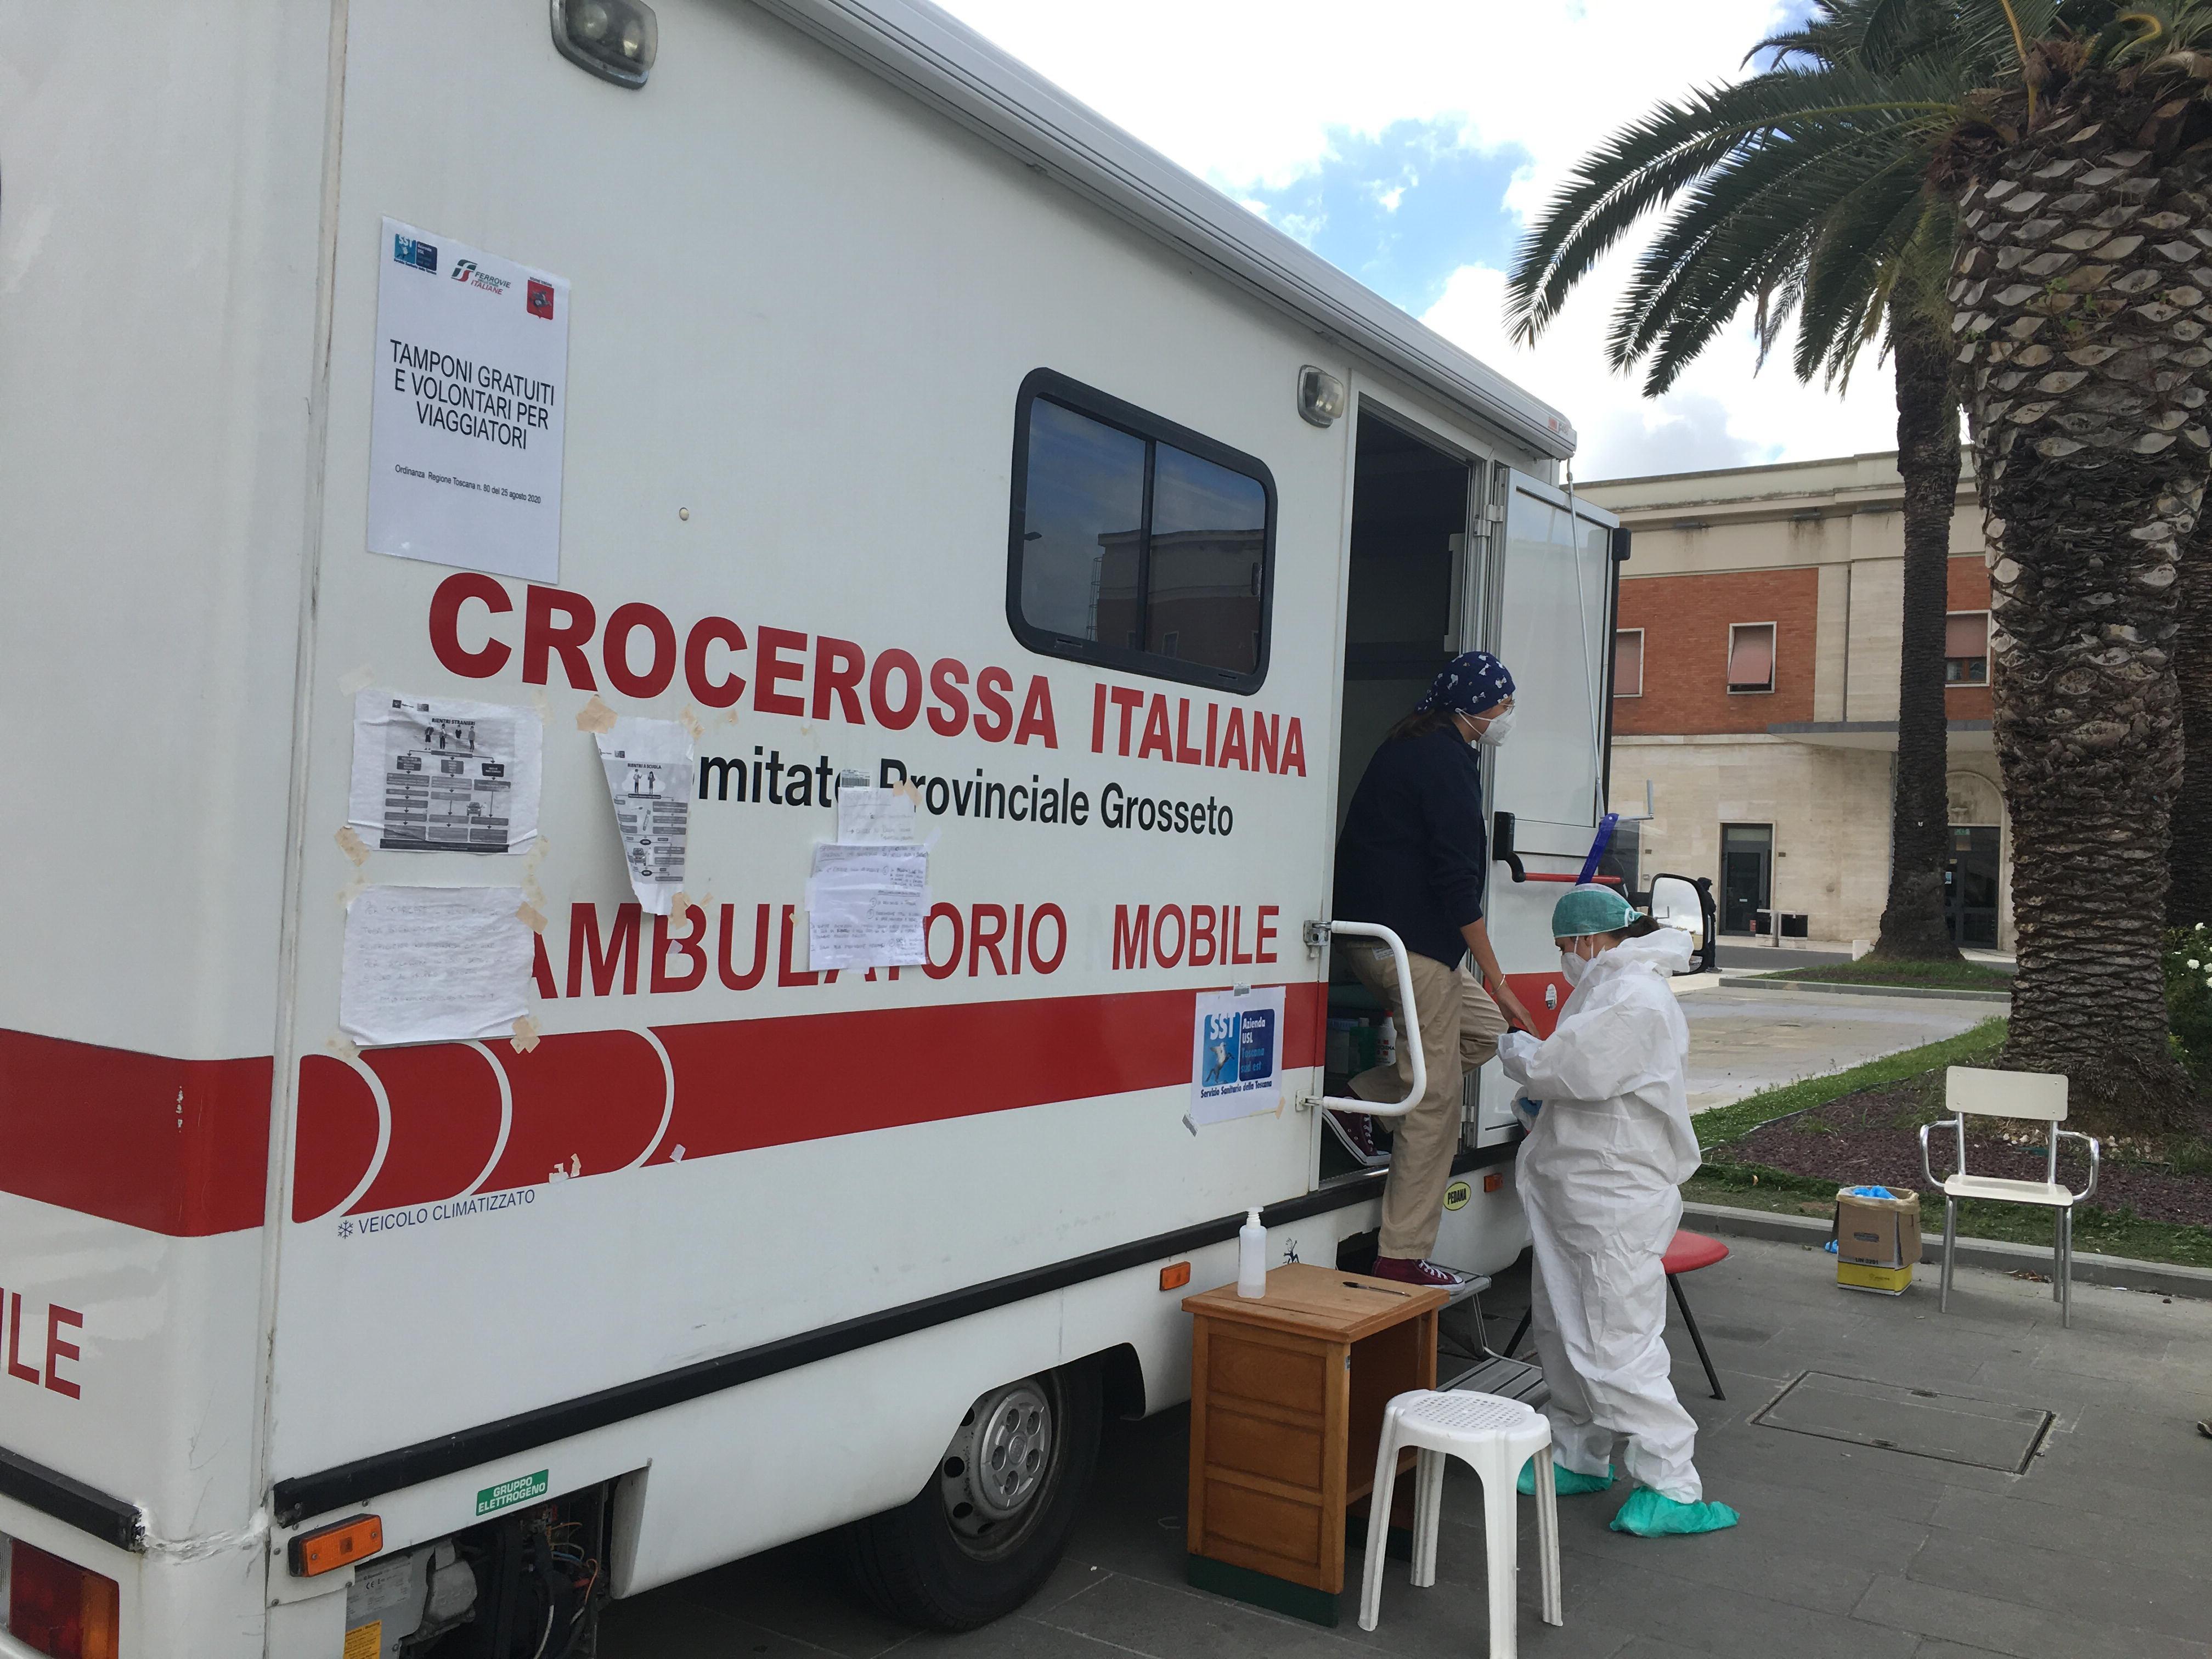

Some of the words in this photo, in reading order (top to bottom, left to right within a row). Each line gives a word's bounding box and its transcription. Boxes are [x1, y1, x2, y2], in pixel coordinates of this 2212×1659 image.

[470, 279, 504, 295] ITALIANE
[475, 271, 511, 289] FERROVIE
[390, 338, 472, 383] TAMPONI
[478, 365, 555, 406] GRATUITI
[394, 368, 405, 392] E
[411, 372, 511, 420] VOLONTARI
[517, 401, 549, 430] PER
[416, 400, 527, 450] VIAGGIATORI
[395, 464, 425, 479] Ordinanza
[428, 471, 452, 484] Regione
[453, 476, 476, 490] Toscana
[492, 486, 500, 495] del
[501, 488, 508, 497] 25
[509, 490, 527, 500] agosto
[528, 494, 541, 504] 2020
[429, 572, 1058, 749] CROCEROSSA
[1091, 683, 1307, 778] ITALIANA
[693, 745, 840, 808] mitat
[879, 758, 1088, 827] Provinciale
[1099, 781, 1234, 837] Grosseto
[532, 899, 1066, 1000] MBULORIO
[1112, 904, 1279, 970] MOBILE
[1210, 1012, 1237, 1041] SST
[1242, 1016, 1266, 1030] Azienda
[1242, 1031, 1253, 1044] USL
[1240, 1061, 1251, 1073] sud
[1252, 1060, 1261, 1071] est
[1242, 1047, 1265, 1059] Toscana
[1200, 1086, 1220, 1098] Servizio
[1221, 1084, 1242, 1095] Sanitario
[1243, 1082, 1254, 1091] della
[1255, 1080, 1272, 1090] Toscana
[358, 1207, 428, 1234] VEICOLO
[432, 1188, 535, 1221] CLIMATIZZATO
[478, 1482, 546, 1513] ELETTROGENO
[493, 1476, 533, 1498] GRUPPO
